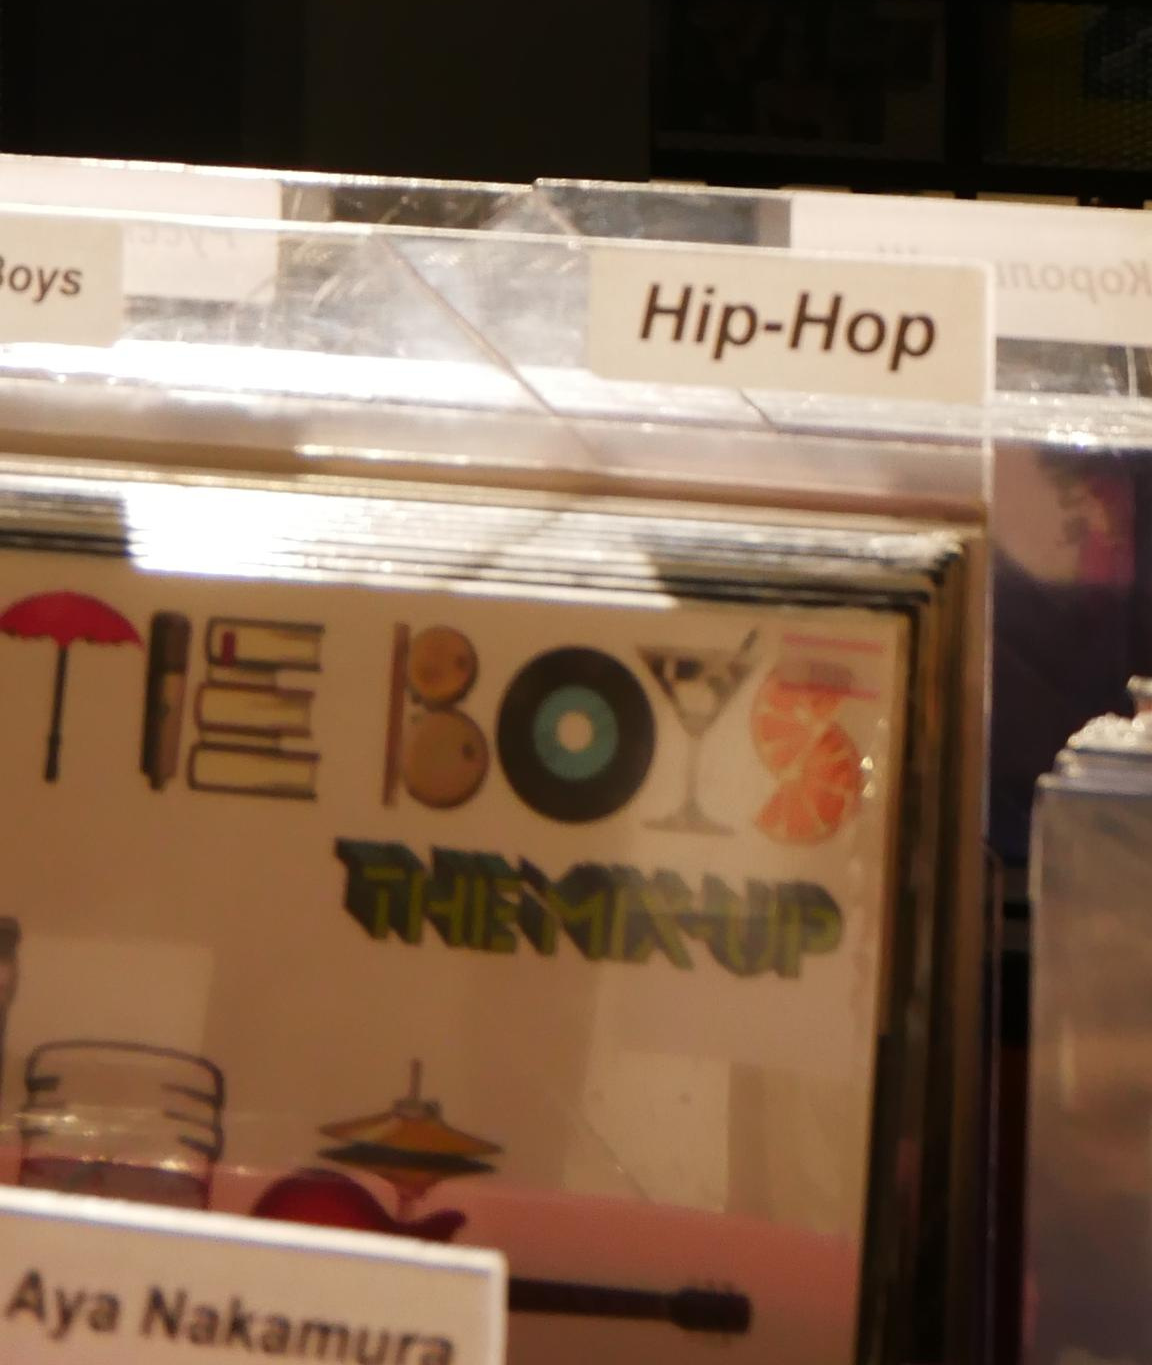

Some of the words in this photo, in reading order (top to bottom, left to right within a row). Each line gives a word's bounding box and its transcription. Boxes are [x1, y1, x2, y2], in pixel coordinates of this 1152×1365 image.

[640, 282, 937, 370] Hip-Hop
[381, 621, 868, 846] BOYS
[335, 836, 522, 954] THE
[5, 1268, 121, 1343] Aya
[140, 1284, 456, 1365] Nakamura
